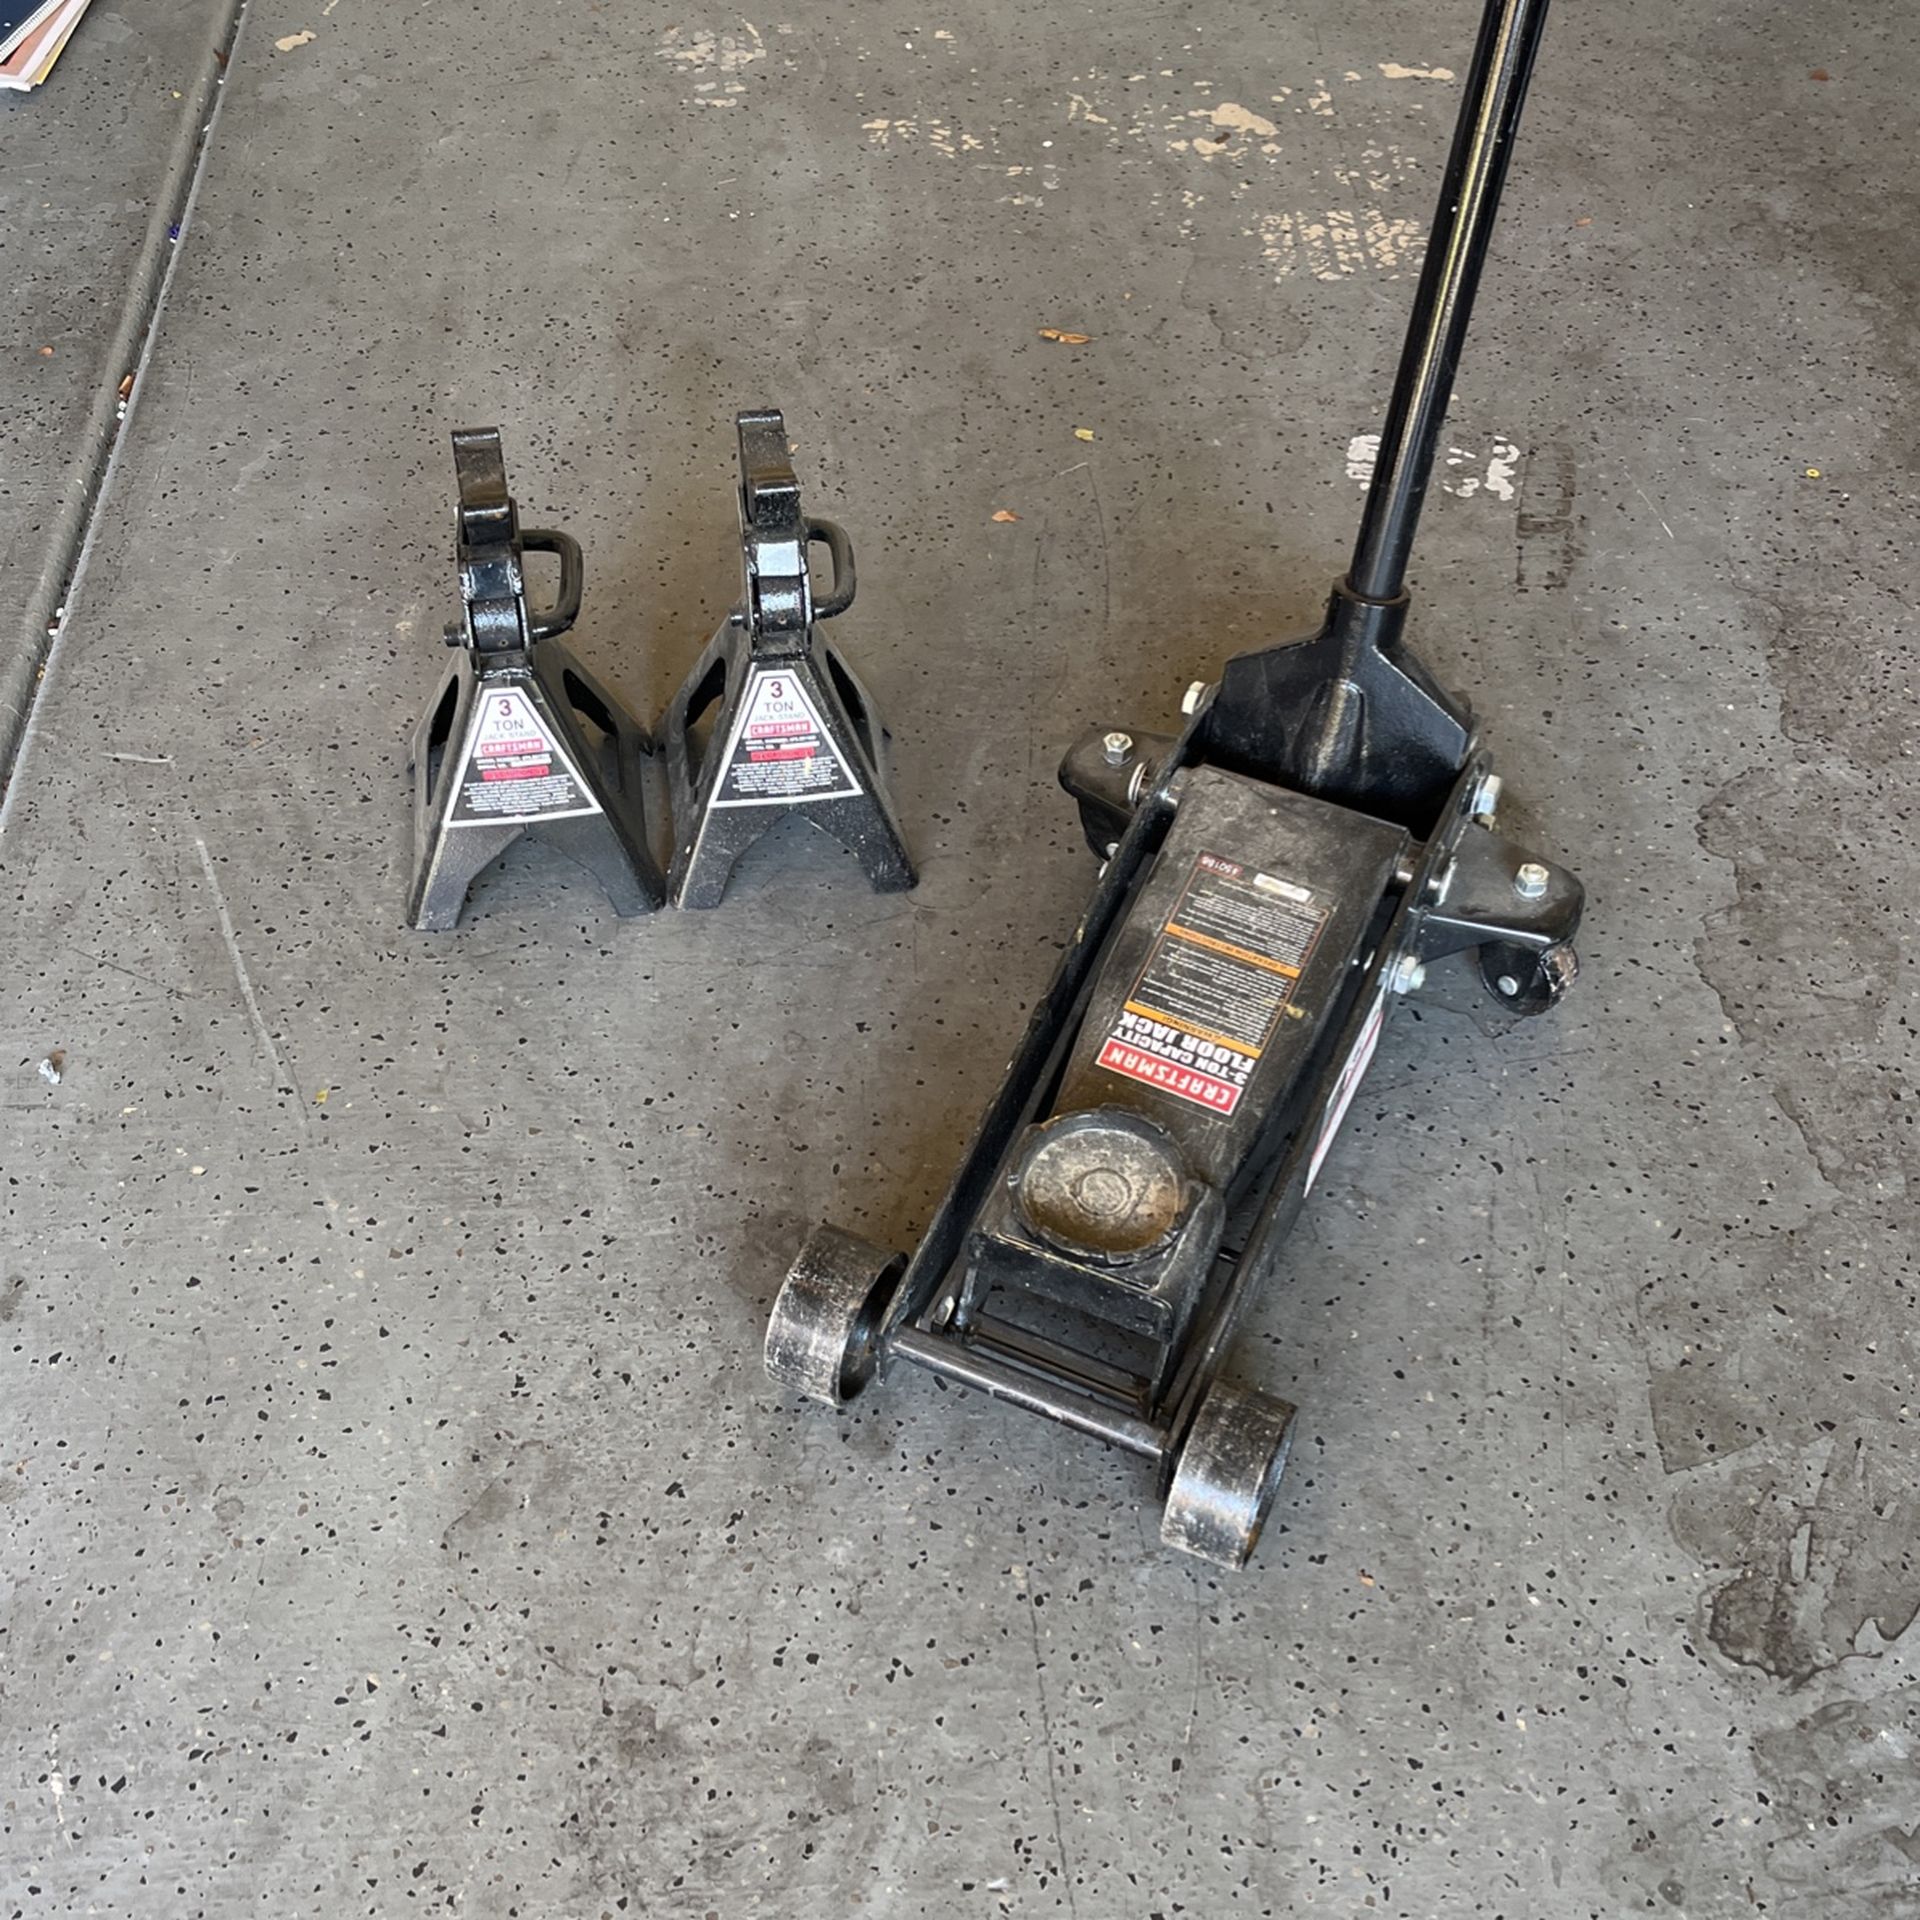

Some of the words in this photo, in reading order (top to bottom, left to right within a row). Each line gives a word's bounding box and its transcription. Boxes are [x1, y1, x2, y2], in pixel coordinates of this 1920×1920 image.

[770, 681, 783, 698] 3
[498, 699, 512, 717] 3
[764, 701, 794, 713] TON
[492, 719, 525, 732] TON
[752, 723, 809, 736] CRAFTSMAN
[482, 740, 541, 754] CRAFTSMAN
[1117, 1009, 1180, 1045] JACK
[1110, 1025, 1195, 1065] CAPACITY
[1178, 1032, 1255, 1073] FLOOR
[1107, 1046, 1231, 1106] CRAFTSMAN
[1193, 1055, 1248, 1085] 3-TON
